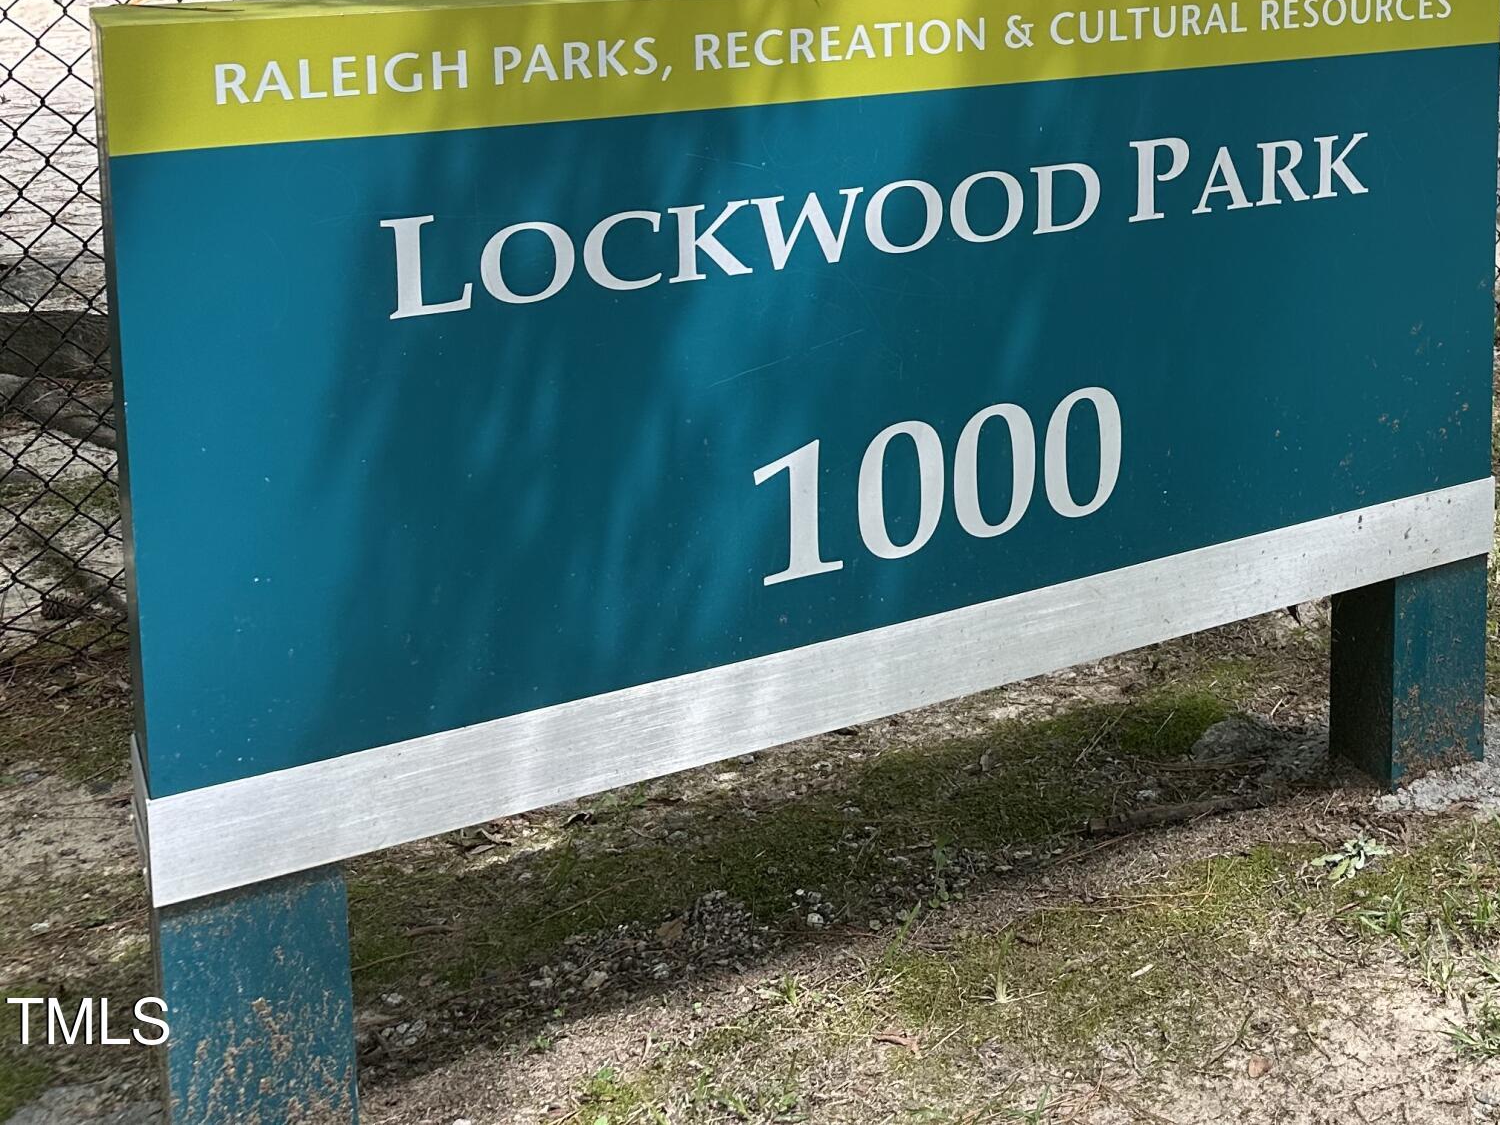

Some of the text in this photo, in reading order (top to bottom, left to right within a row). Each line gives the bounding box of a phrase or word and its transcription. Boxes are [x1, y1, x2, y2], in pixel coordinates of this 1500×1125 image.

[213, 49, 469, 106] RALEIGH
[493, 36, 674, 85] PARKS,
[694, 17, 987, 71] RECREATION
[1004, 14, 1035, 49] &
[1049, 0, 1248, 46] CULTURAL
[380, 131, 1369, 320] LOCKWOOD PARK
[752, 385, 1122, 587] 1000
